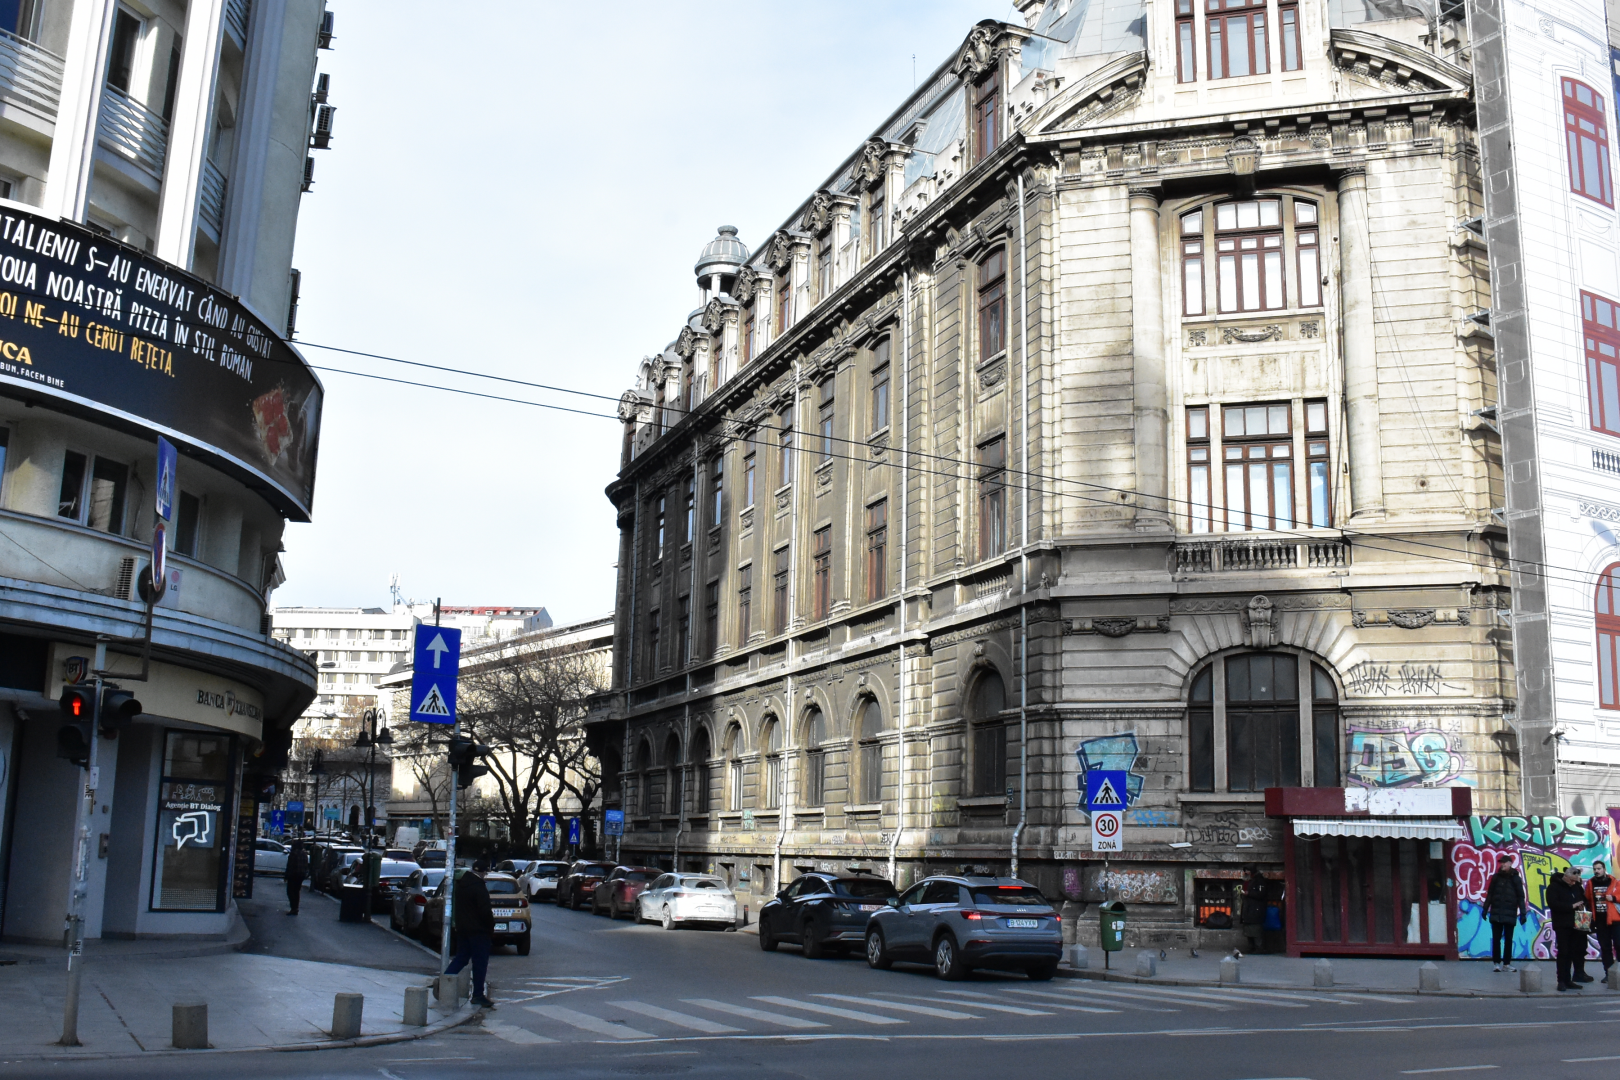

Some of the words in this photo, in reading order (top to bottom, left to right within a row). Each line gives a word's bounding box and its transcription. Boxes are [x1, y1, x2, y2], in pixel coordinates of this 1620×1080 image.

[0, 213, 80, 266] TALIENII
[135, 267, 194, 312] ENERVAT
[198, 294, 228, 330] CÂND
[231, 313, 246, 340] AU
[246, 325, 273, 359] GUSTAT
[0, 254, 37, 291] OUA
[129, 301, 168, 340] PIZZA
[174, 316, 190, 348] ÎN
[193, 331, 216, 362] STIL
[220, 344, 253, 384] ROMAN.
[0, 291, 18, 320] OI
[86, 322, 125, 353] CERUT
[20, 367, 45, 382] FACEM
[47, 375, 65, 388] BINE
[68, 662, 79, 674] BT
[197, 689, 225, 709] BANCA
[189, 802, 199, 810] BT
[200, 802, 222, 812] Dialog
[1099, 819, 1115, 832] 30
